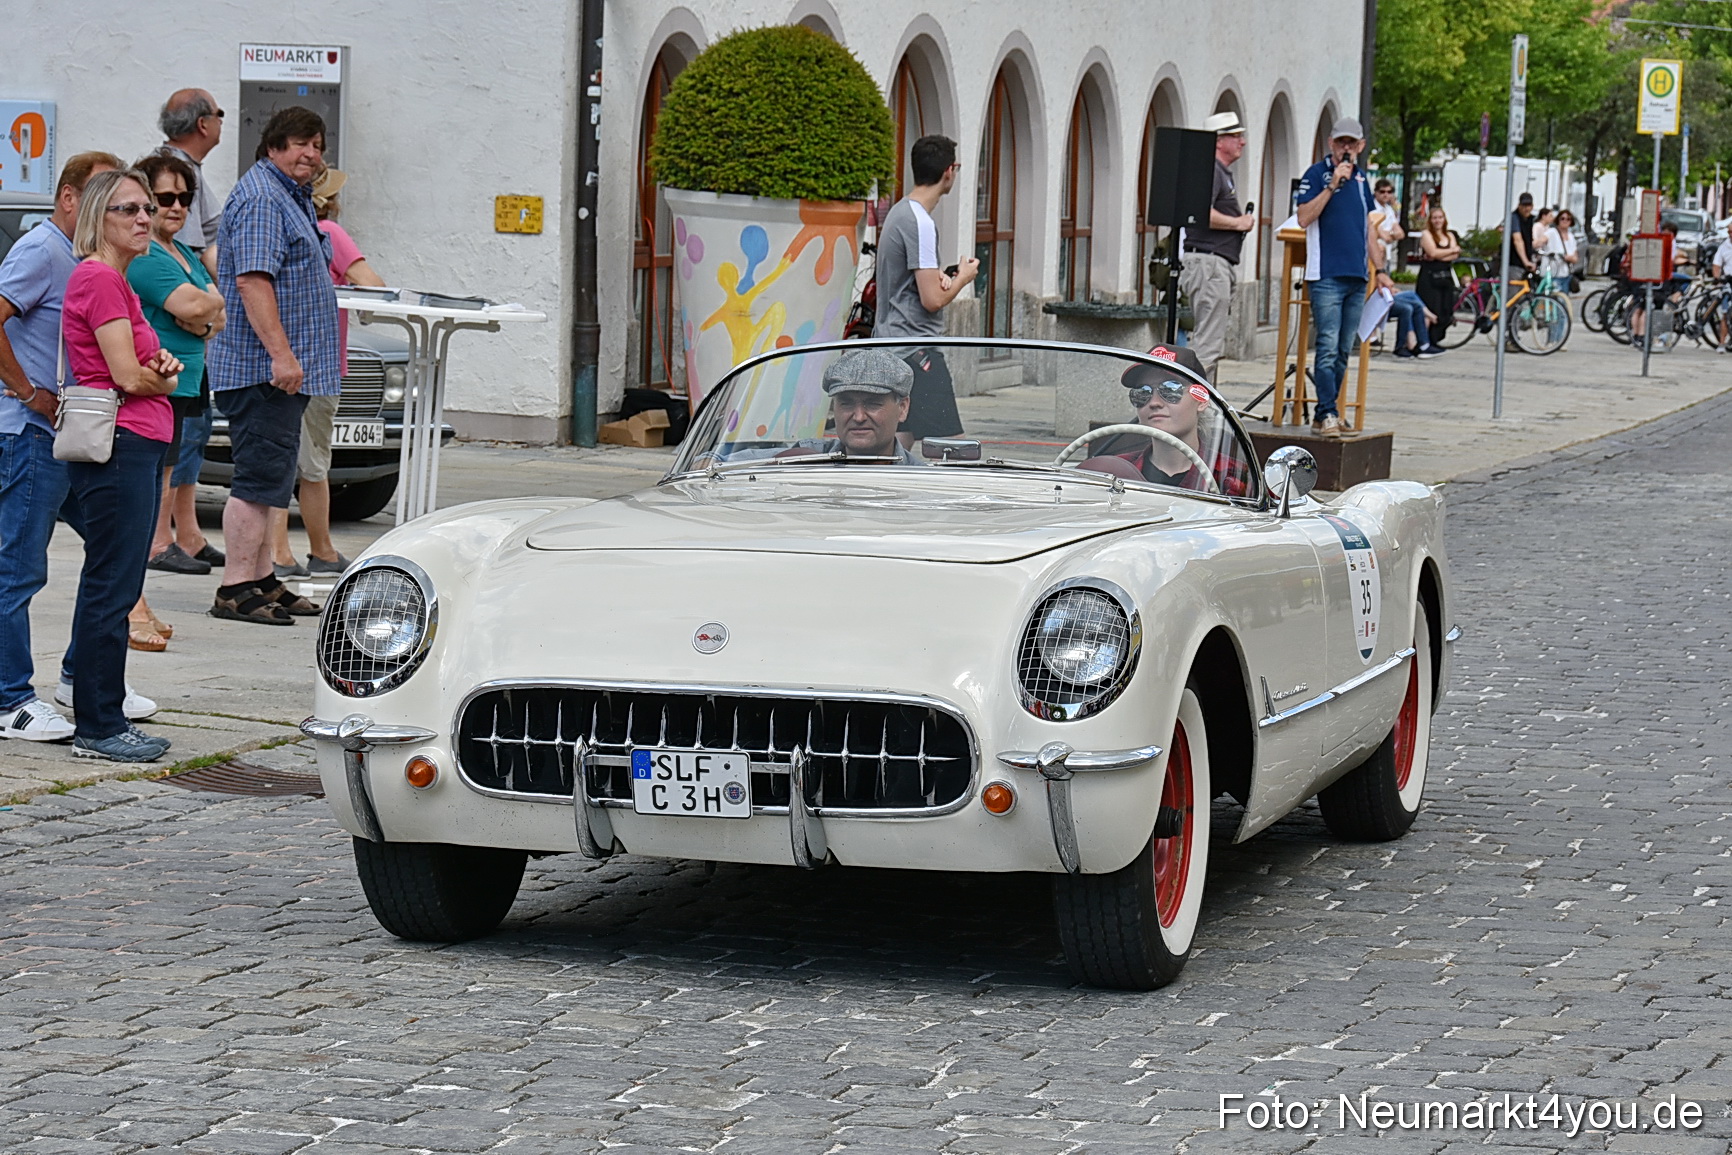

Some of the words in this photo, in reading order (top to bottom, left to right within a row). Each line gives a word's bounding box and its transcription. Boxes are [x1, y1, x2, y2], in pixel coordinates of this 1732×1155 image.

[245, 48, 323, 63] NEUMARKT
[334, 424, 350, 443] TZ
[353, 424, 375, 444] 684
[1361, 580, 1371, 615] 35
[638, 768, 646, 778] D
[656, 754, 711, 782] SLF
[652, 784, 668, 811] C
[682, 785, 721, 813] 3H
